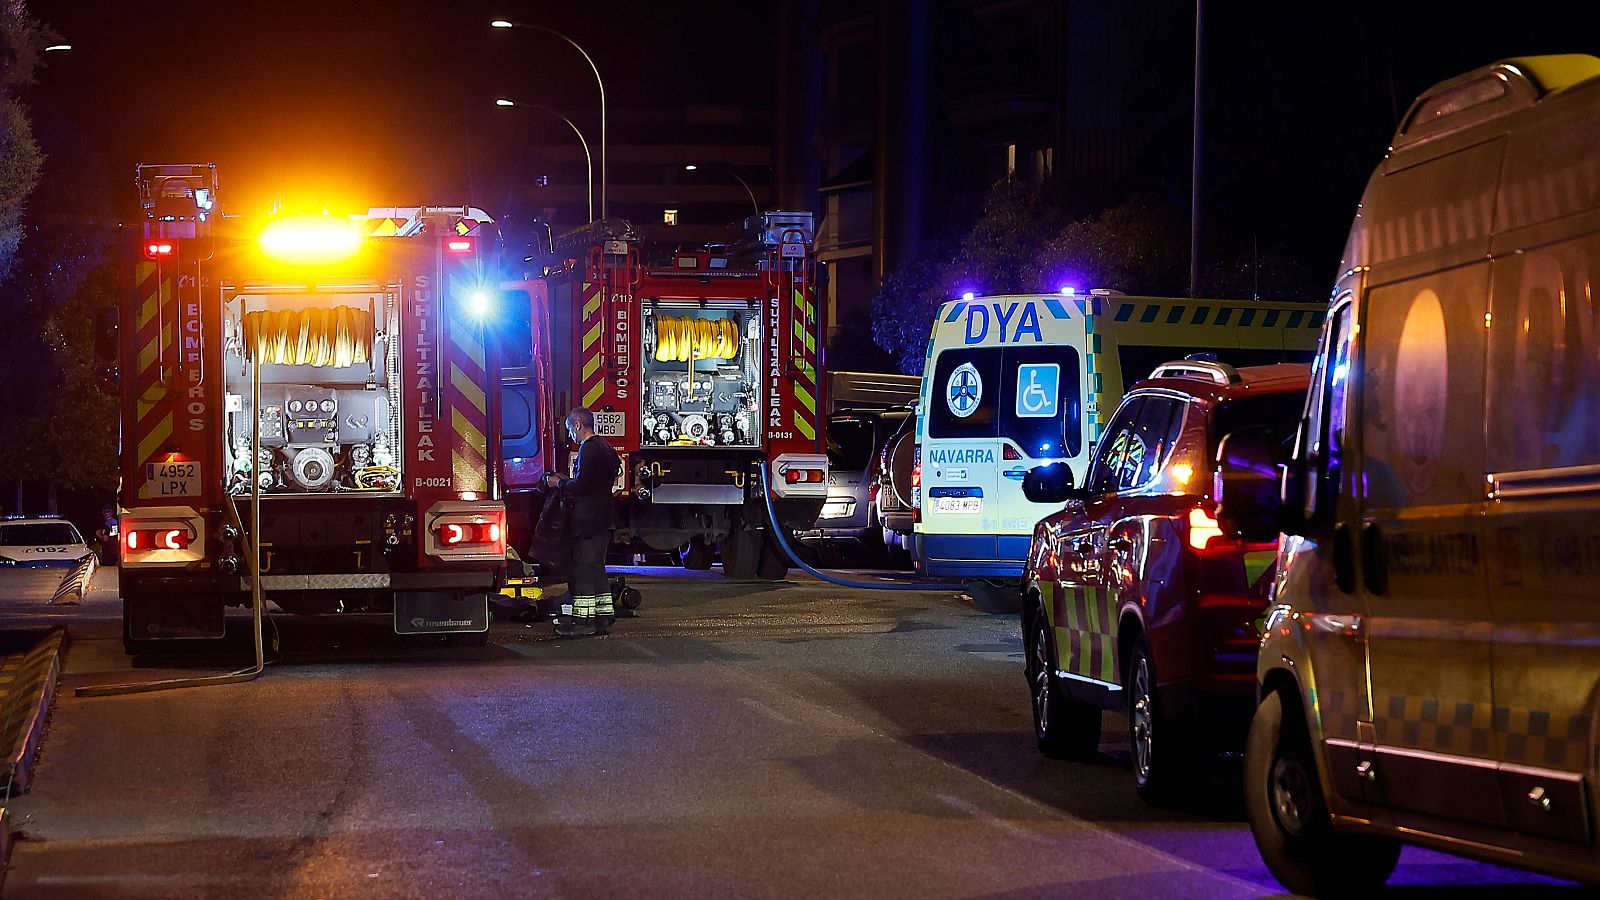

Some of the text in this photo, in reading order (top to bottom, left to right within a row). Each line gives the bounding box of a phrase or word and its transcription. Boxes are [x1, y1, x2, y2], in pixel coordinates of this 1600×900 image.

[618, 294, 633, 303] 112
[965, 302, 1043, 344] DYA
[414, 275, 435, 462] SUHILTZAILEAK
[597, 414, 621, 424] 5562
[597, 424, 616, 434] MBG
[768, 431, 793, 439] B-0131
[929, 449, 994, 464] NAVARRA
[159, 464, 195, 478] 4952
[415, 477, 451, 487] B-0021
[161, 481, 187, 495] LPX
[940, 500, 960, 511] 4083
